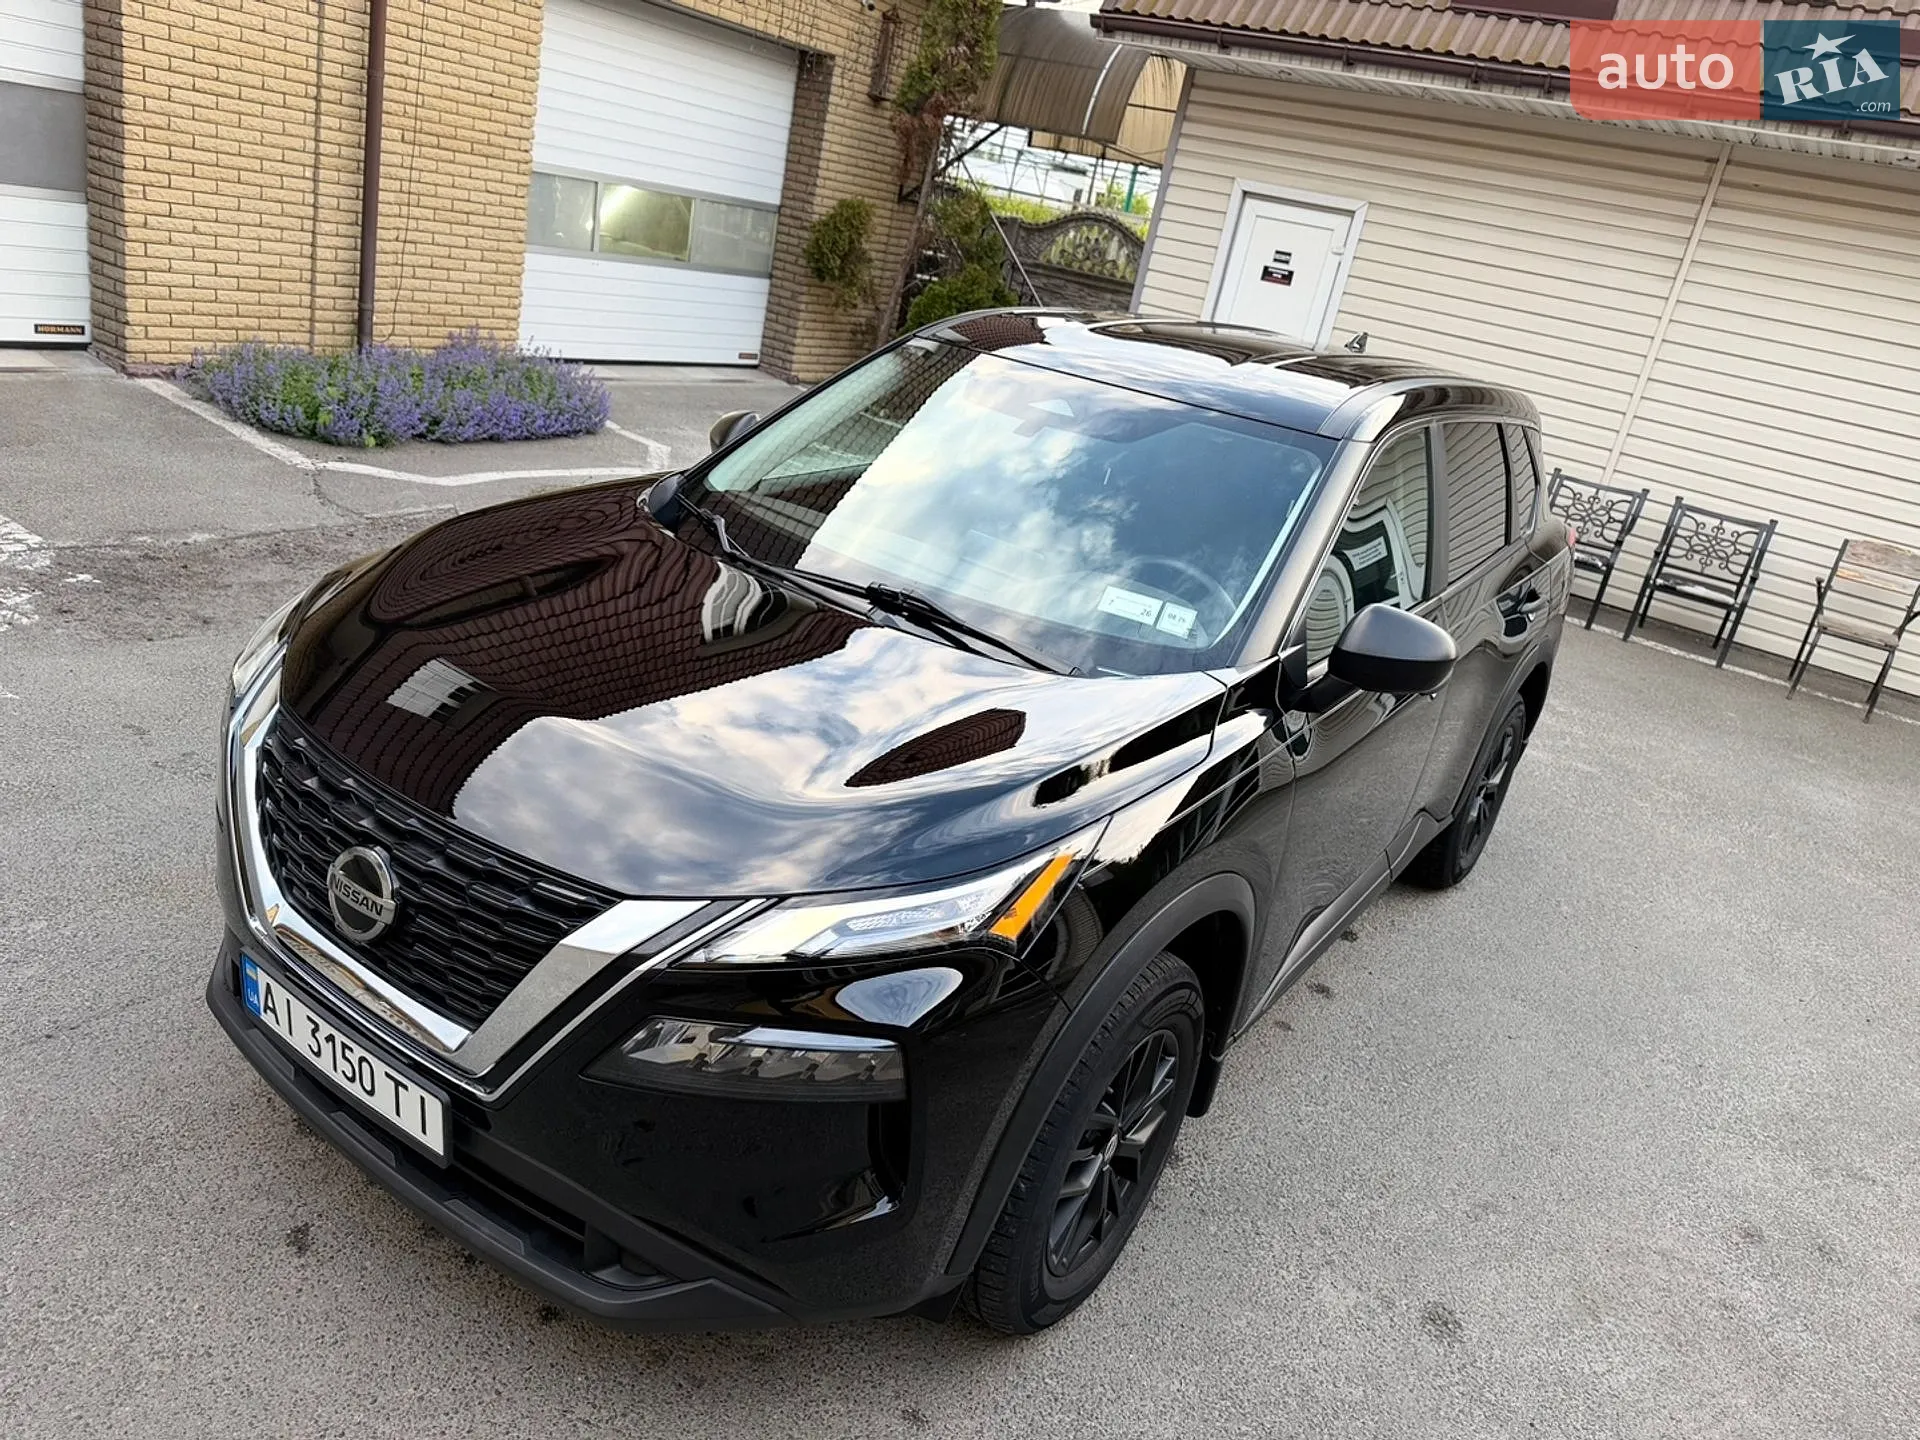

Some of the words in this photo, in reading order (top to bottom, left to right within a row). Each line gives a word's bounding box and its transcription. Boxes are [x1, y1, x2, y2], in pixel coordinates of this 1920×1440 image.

[335, 878, 384, 916] NISSAN
[262, 981, 294, 1038] AI
[305, 1014, 376, 1098] 3150
[384, 1070, 428, 1137] TI
